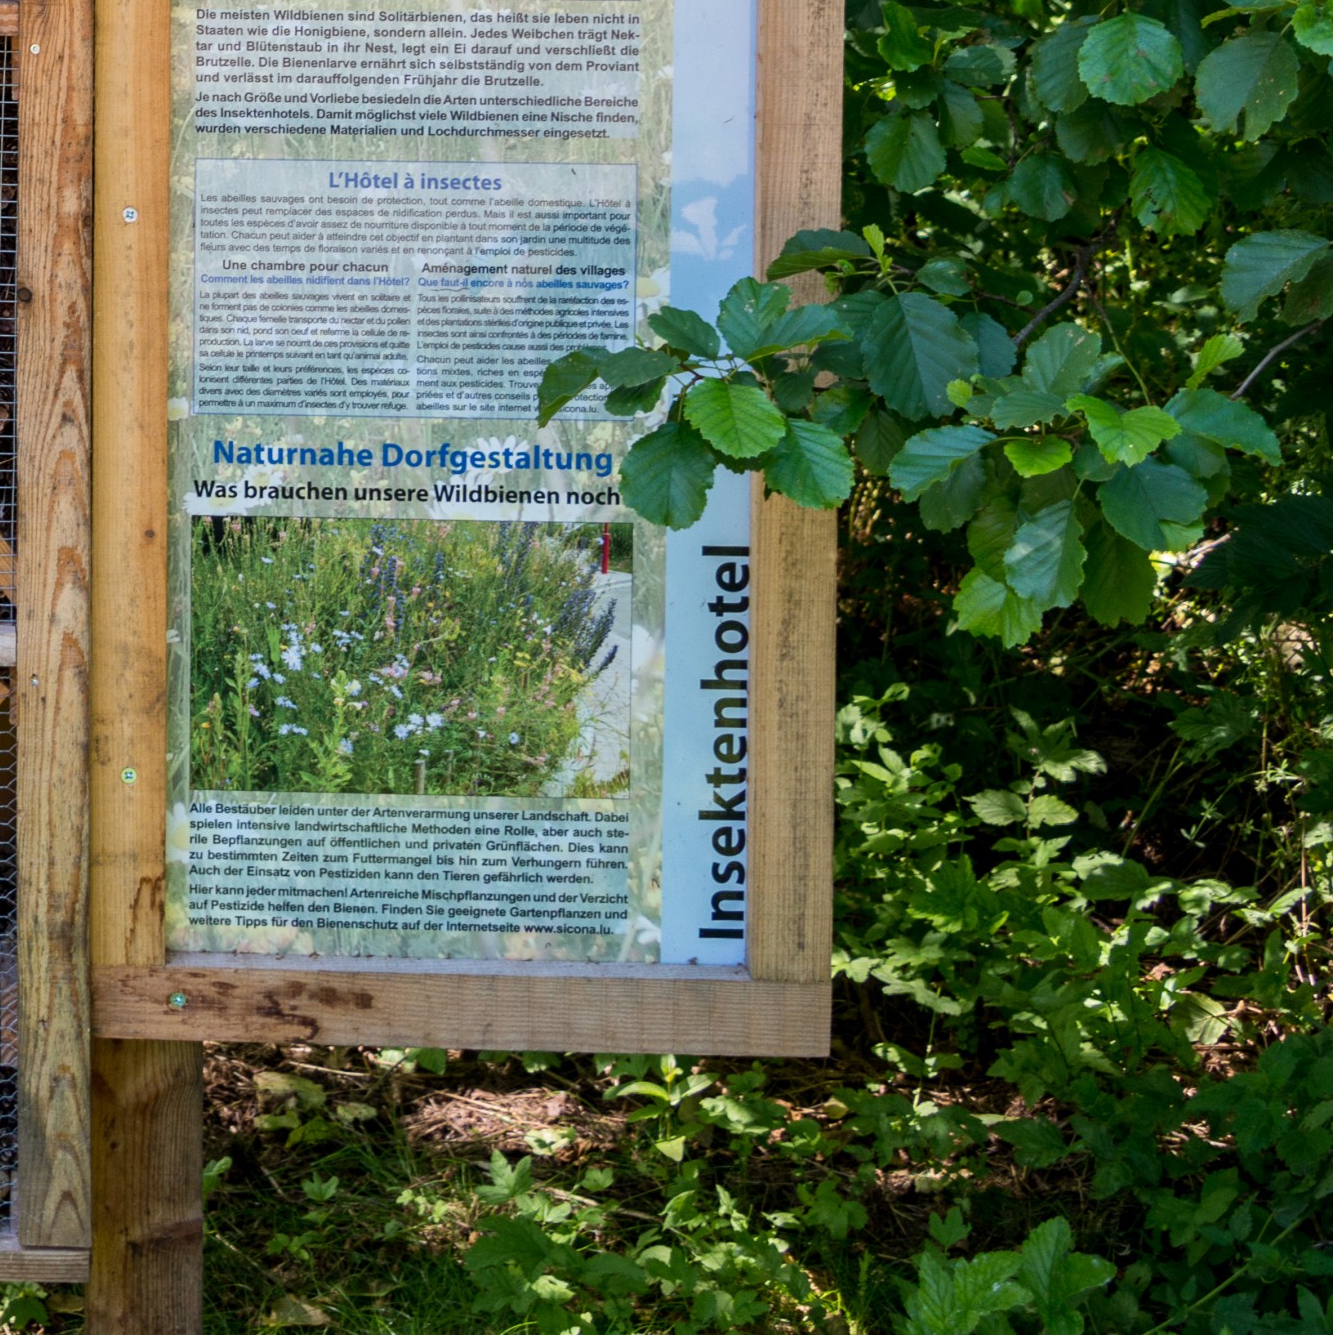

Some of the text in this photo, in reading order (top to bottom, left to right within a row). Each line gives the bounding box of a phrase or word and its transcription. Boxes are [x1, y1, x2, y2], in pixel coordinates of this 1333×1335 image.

[402, 172, 415, 189] à
[420, 172, 502, 191] insectes
[222, 259, 388, 274] Une chambre pour chacun
[422, 262, 627, 278] Aménagement naturel des villages
[212, 441, 613, 477] Naturnahe Dorfgestaltung
[193, 478, 237, 499] Was
[243, 479, 348, 501] brauchen
[351, 486, 428, 502] unsere
[432, 483, 559, 505] Wildbienen
[698, 545, 750, 939] Insektenhotel
[188, 914, 614, 935] weitere Tipps für den Bienenschutz auf der Internetseite www.sicona.lu.
